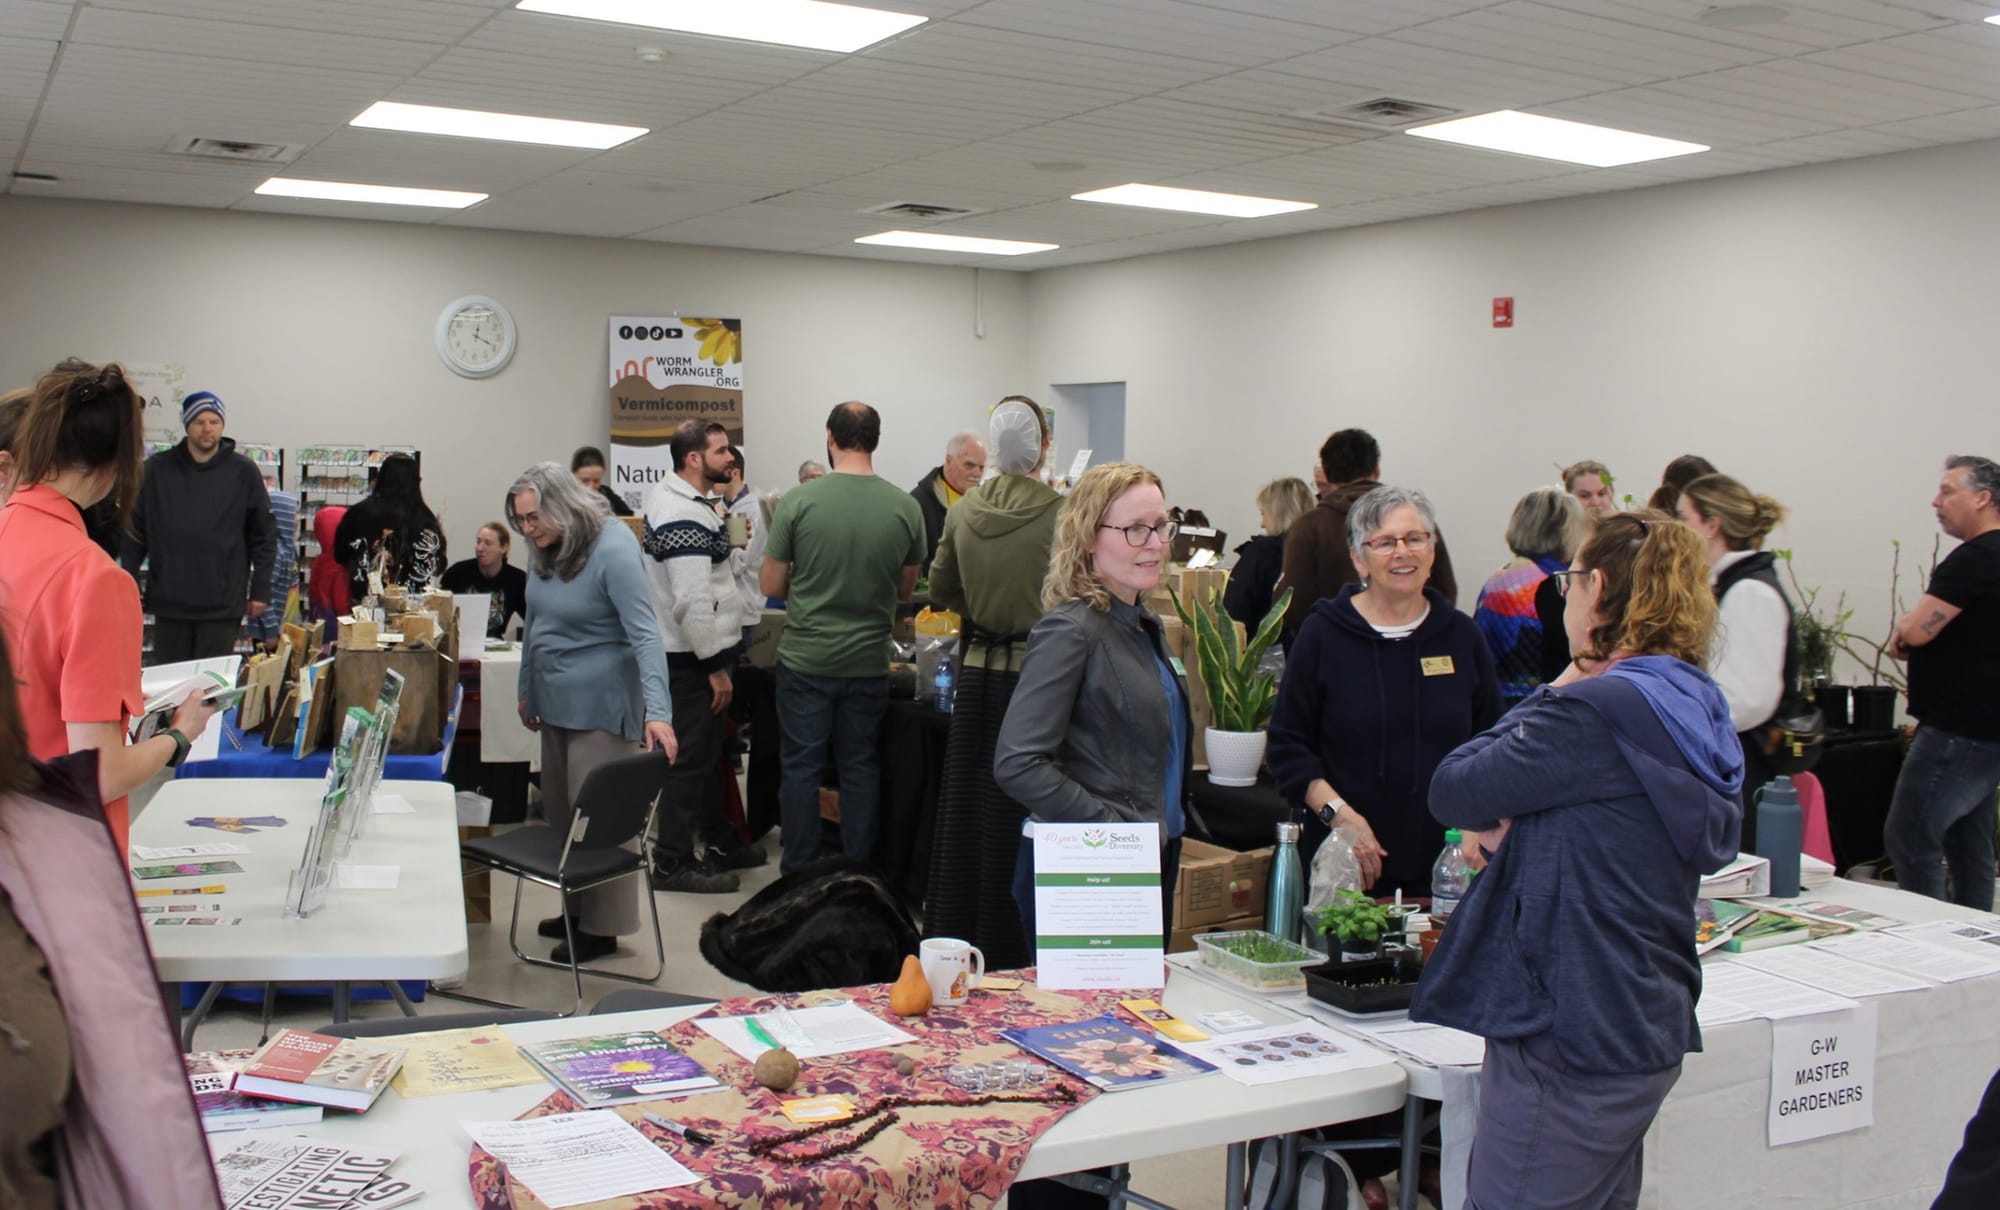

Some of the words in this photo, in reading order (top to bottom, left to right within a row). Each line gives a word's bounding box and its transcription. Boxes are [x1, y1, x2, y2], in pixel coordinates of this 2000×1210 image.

[656, 357, 692, 366] WORM
[664, 367, 723, 377] WRANGLER
[713, 377, 739, 387] .ORG
[617, 397, 736, 413] Vermicompost
[1110, 832, 1140, 843] Seeds
[1052, 1026, 1120, 1040] SEEDS
[1811, 1036, 1838, 1056] G-W
[1795, 1061, 1850, 1086] MASTER
[1778, 1085, 1863, 1117] GARDENERS
[240, 1146, 342, 1210] ESTIGATING
